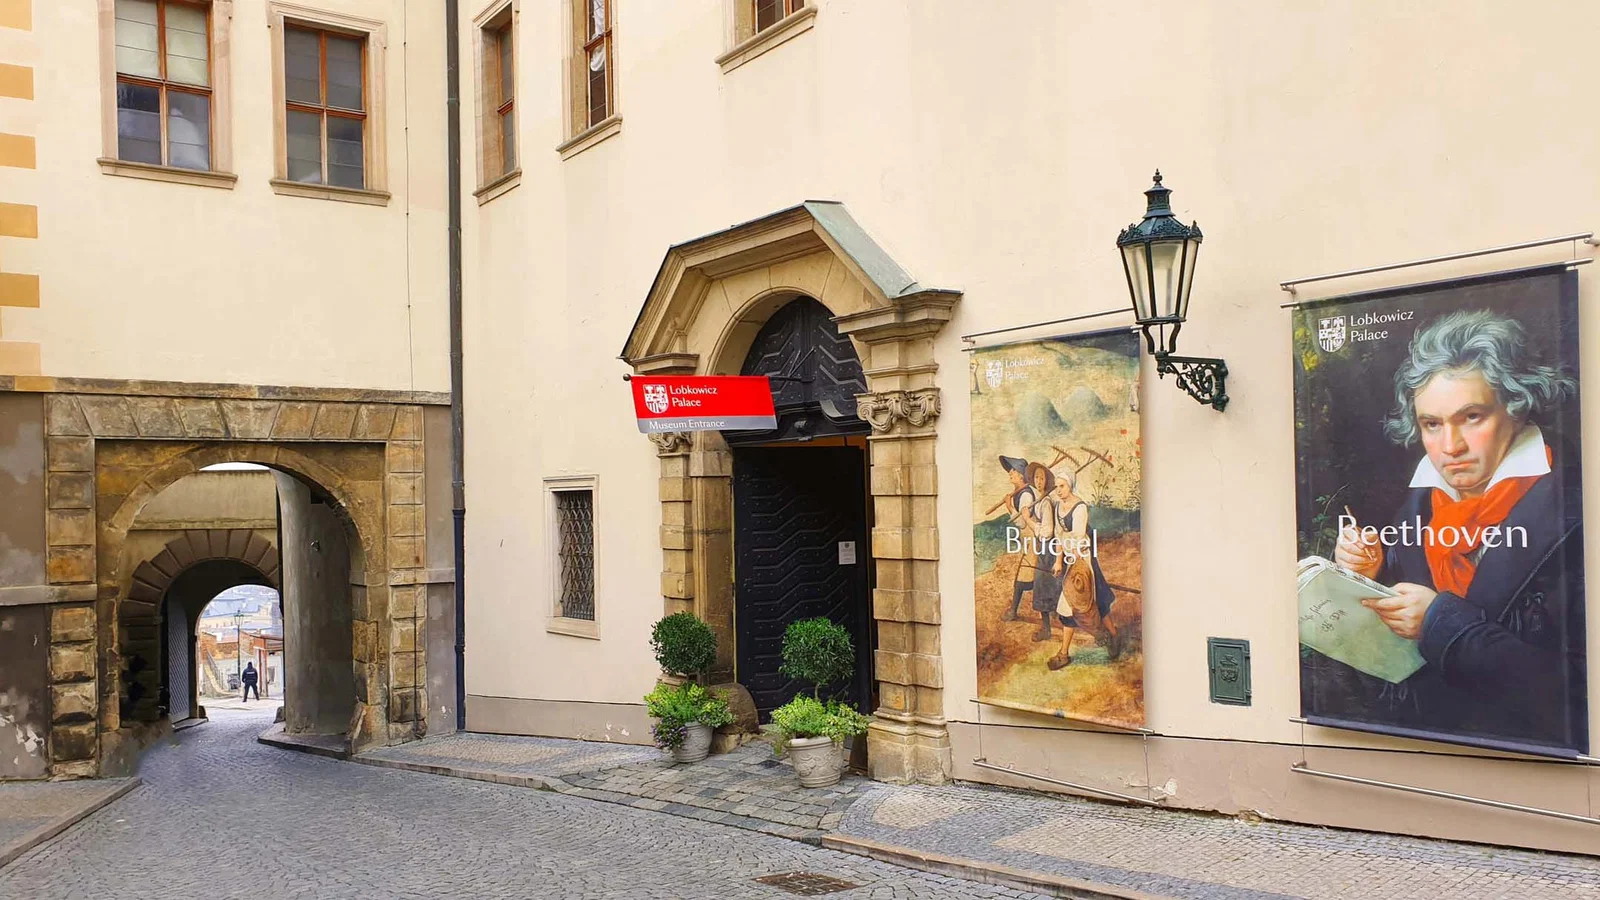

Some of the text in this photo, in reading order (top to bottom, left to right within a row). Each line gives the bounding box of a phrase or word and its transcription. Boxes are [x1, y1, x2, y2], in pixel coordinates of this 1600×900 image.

[1350, 309, 1414, 327] Lobkowicz
[1350, 329, 1389, 342] Palace
[1005, 355, 1044, 368] Lobkowicz
[1005, 371, 1029, 380] Palace
[669, 385, 718, 395] Lobkowicz
[672, 397, 701, 407] Palace
[649, 419, 726, 430] Museum Entrance
[1338, 514, 1528, 548] Beethoven
[1006, 526, 1098, 565] Bruegel
